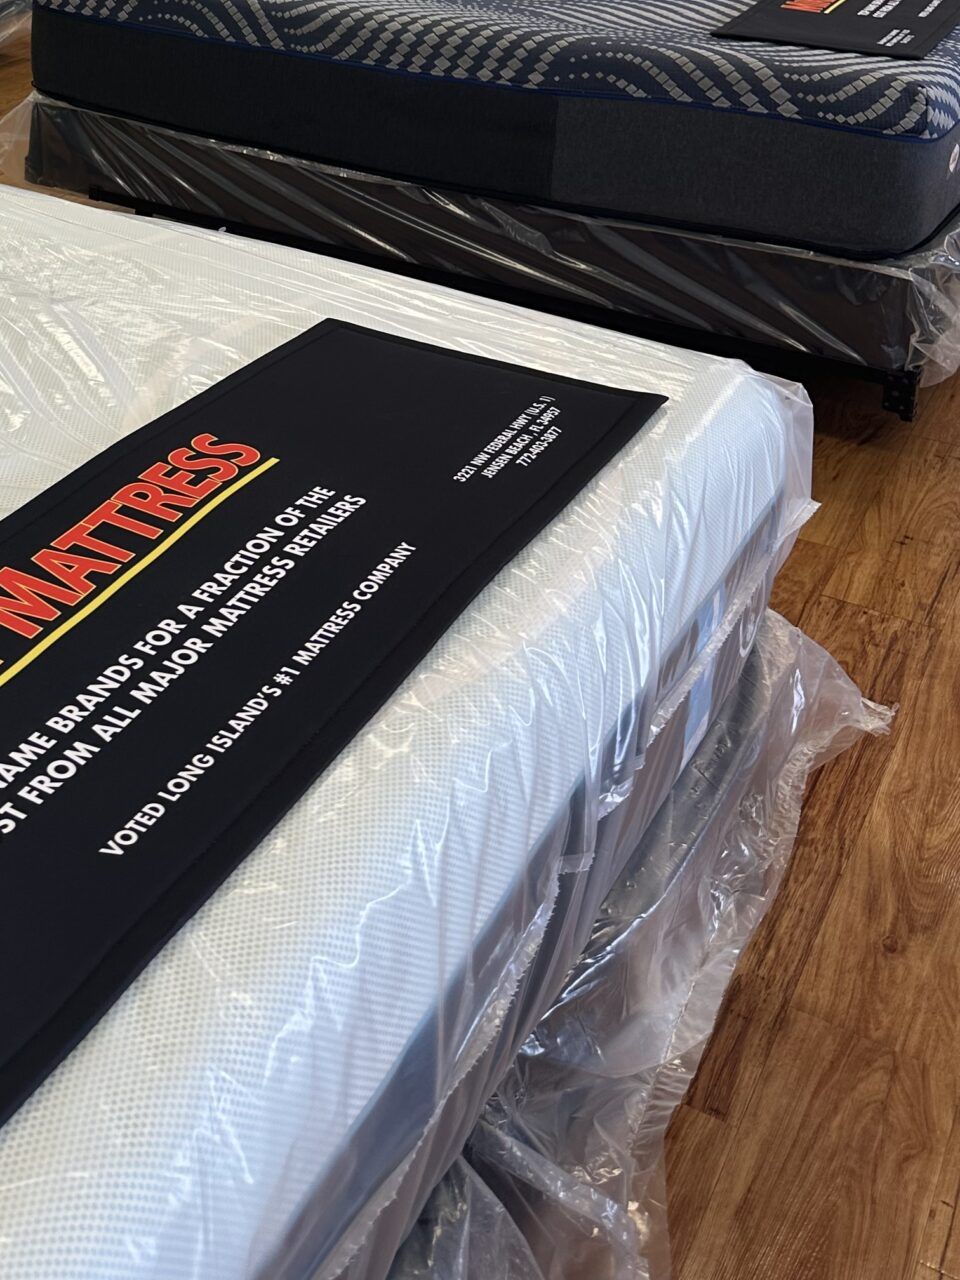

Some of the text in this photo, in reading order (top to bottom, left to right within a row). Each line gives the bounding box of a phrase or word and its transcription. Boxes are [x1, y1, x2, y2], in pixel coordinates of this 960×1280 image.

[453, 465, 478, 482] 3221
[470, 451, 491, 466] NW
[483, 429, 518, 453] FEDERAL
[509, 413, 532, 429] HWY
[481, 453, 513, 478] JENSEN
[536, 406, 561, 425] 34957
[515, 425, 562, 467] 772-403-3877
[17, 741, 101, 805] FROM
[91, 705, 142, 743] ALL
[129, 637, 214, 705] MAJOR
[201, 555, 295, 638] MATTRESS
[282, 494, 367, 557] RETAILERS
[45, 654, 144, 734] BRANDS
[133, 619, 188, 656] FOR
[177, 603, 205, 620] A
[191, 526, 285, 603] FRACTION
[274, 506, 306, 527] OF
[295, 486, 337, 509] THE
[98, 541, 417, 855] VOTED LONG ISLAND'S #1 MATTRESS COMPANY
